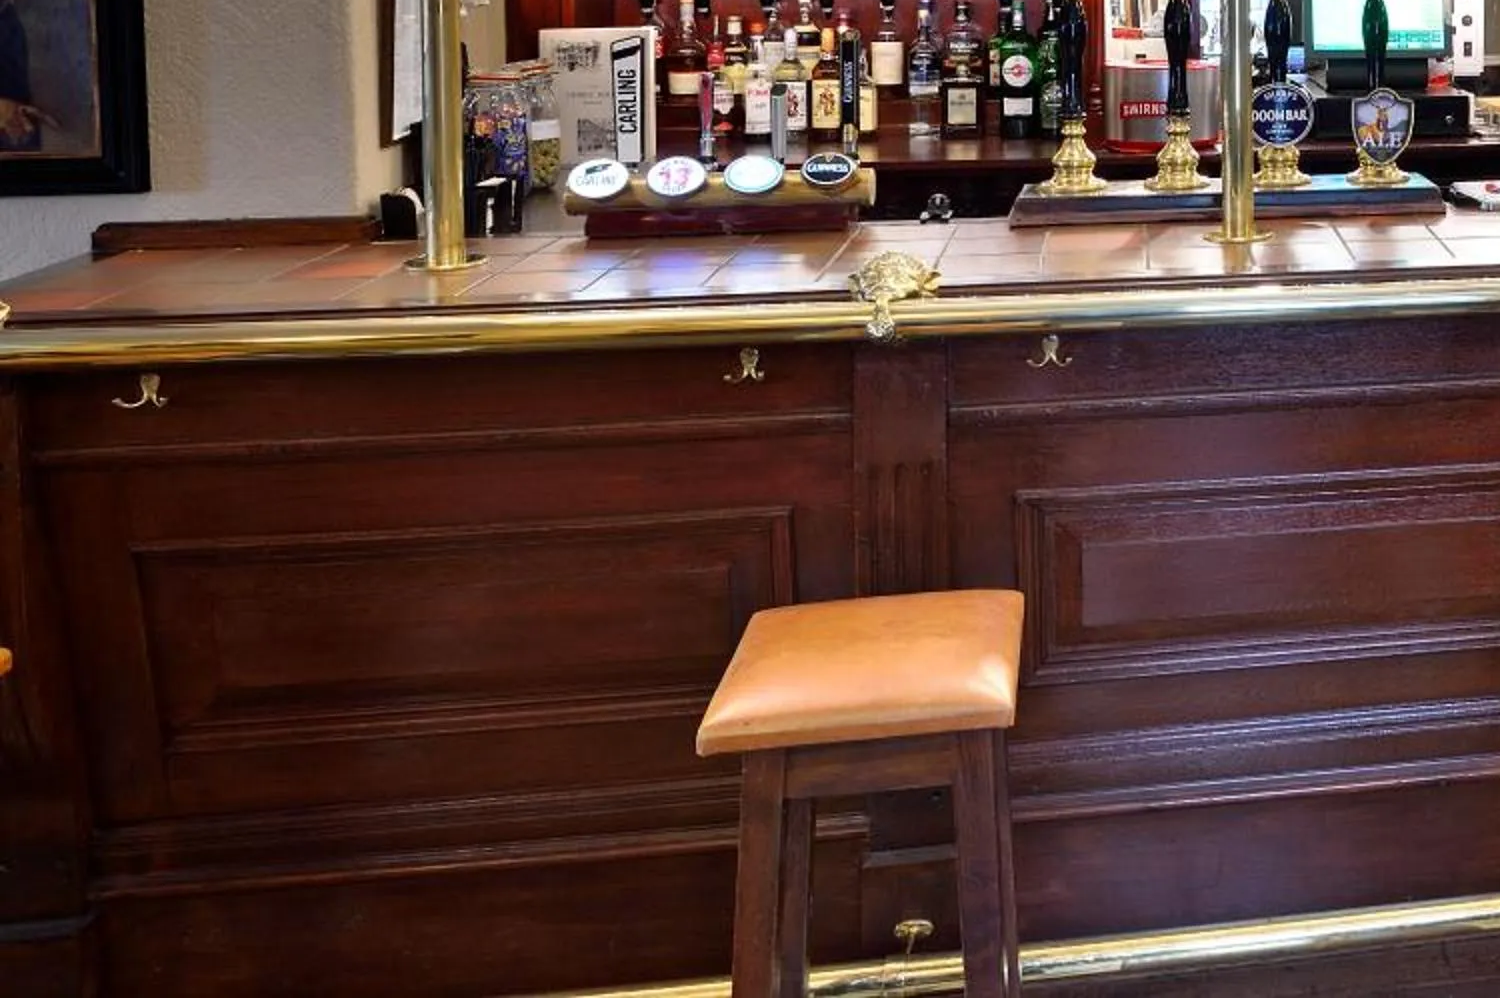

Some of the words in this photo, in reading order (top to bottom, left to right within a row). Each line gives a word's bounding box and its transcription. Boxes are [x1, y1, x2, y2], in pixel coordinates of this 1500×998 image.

[617, 69, 637, 134] CARLING
[1123, 103, 1168, 116] SMIRNO
[1252, 109, 1285, 122] DOOM
[1286, 109, 1308, 121] BAR
[1362, 131, 1405, 147] ALE
